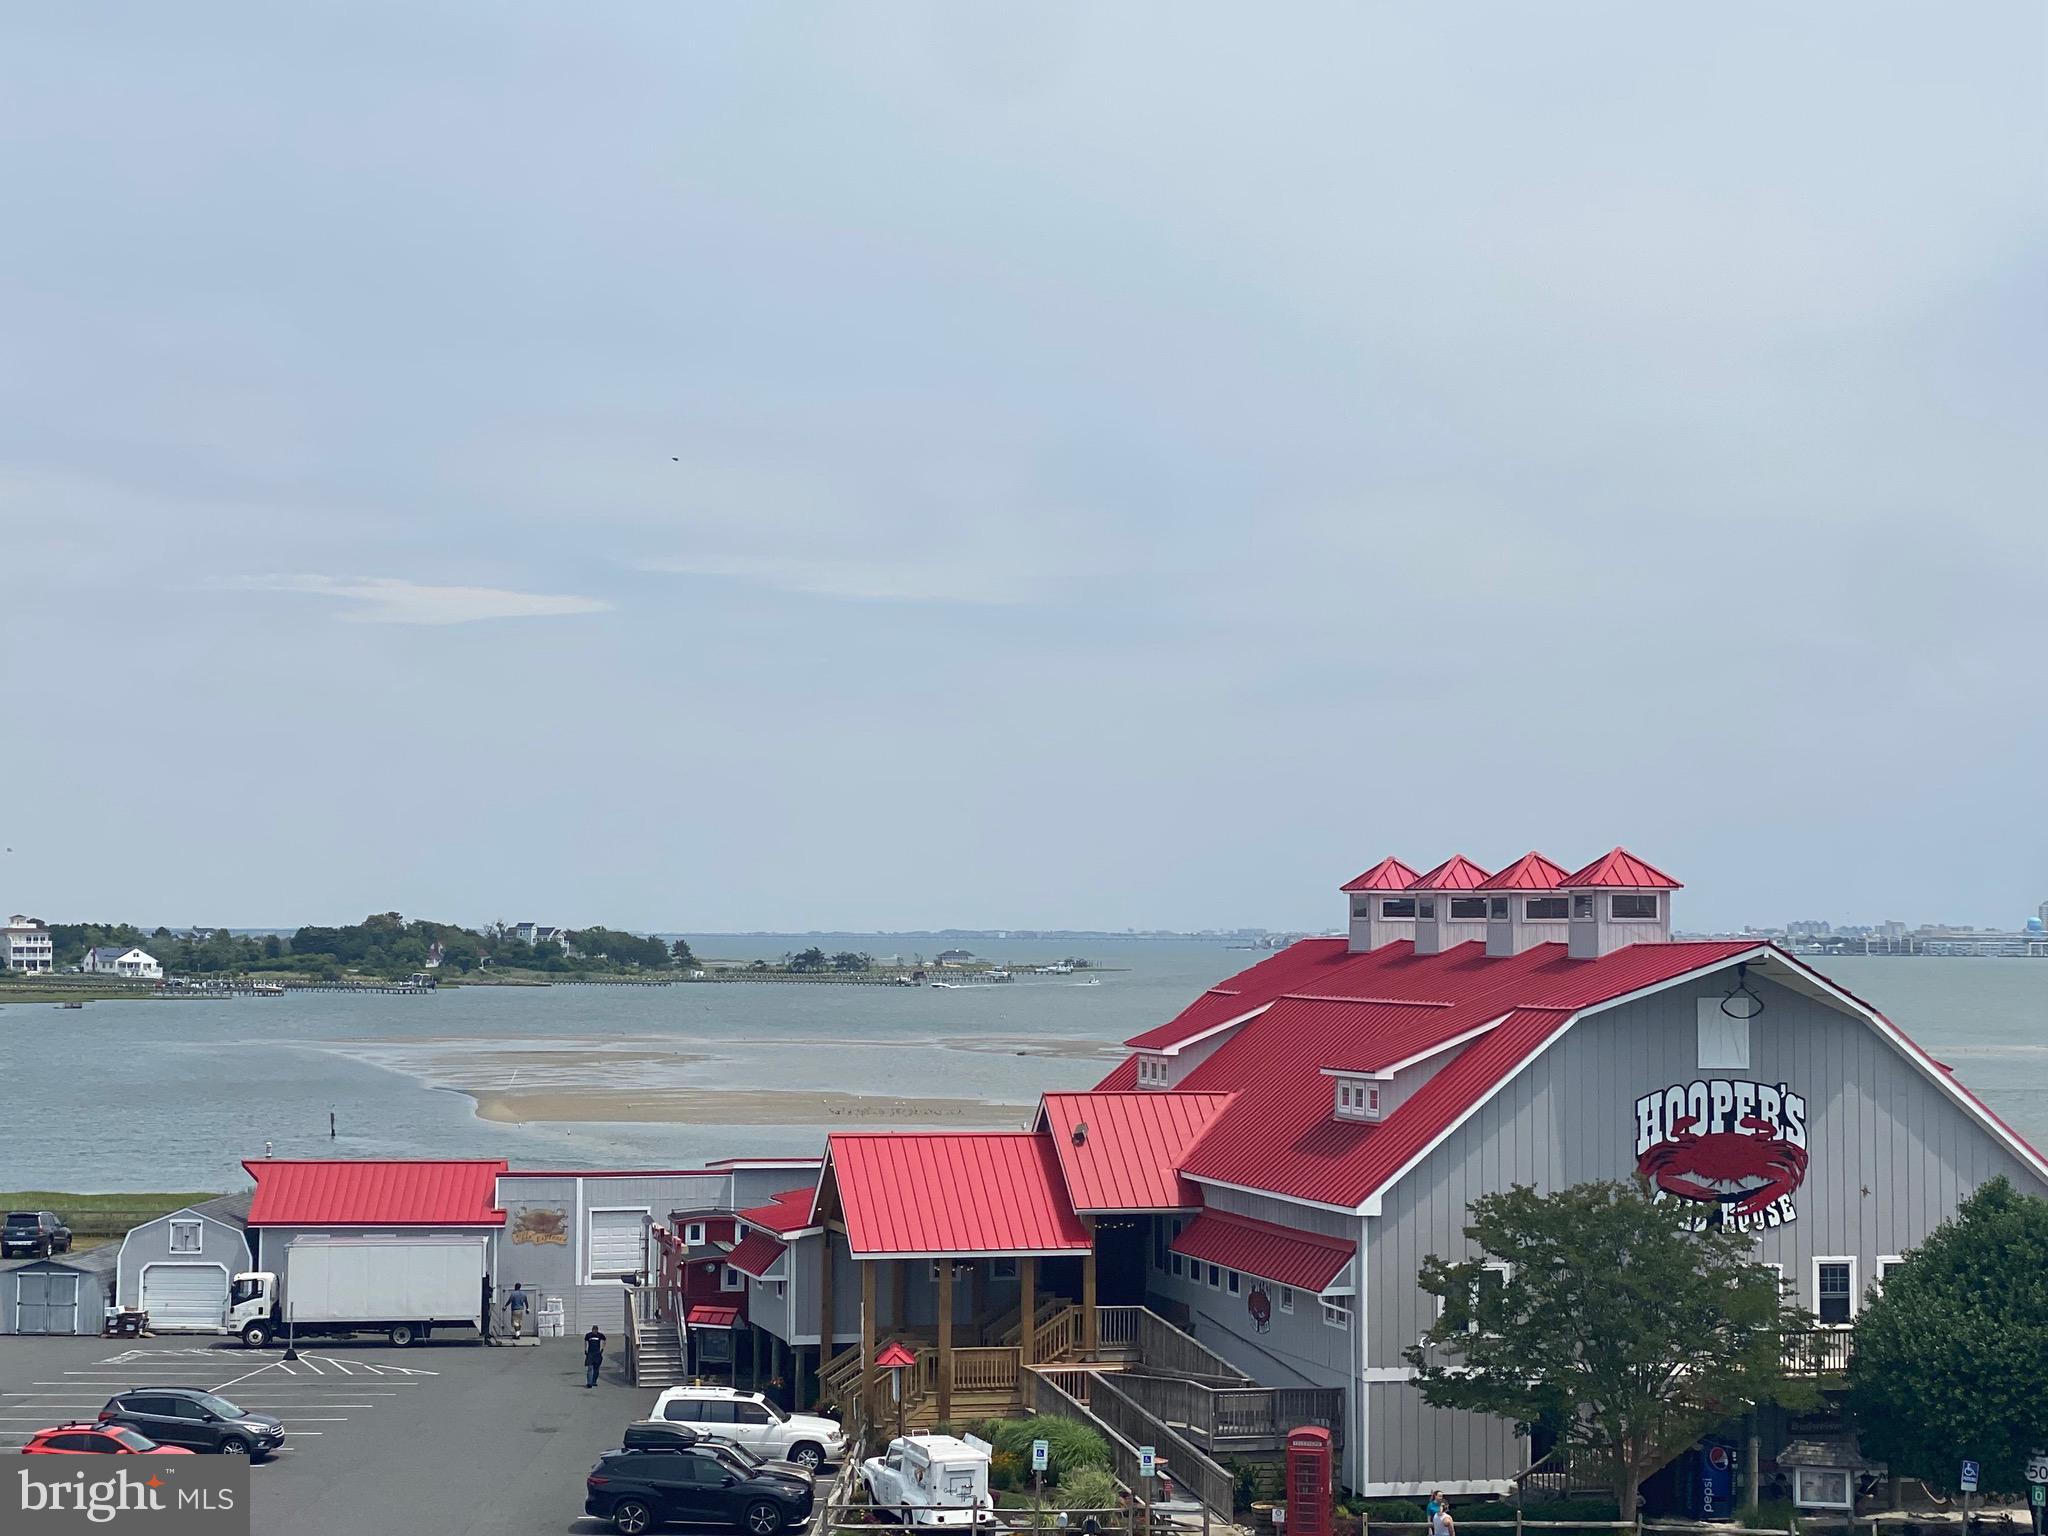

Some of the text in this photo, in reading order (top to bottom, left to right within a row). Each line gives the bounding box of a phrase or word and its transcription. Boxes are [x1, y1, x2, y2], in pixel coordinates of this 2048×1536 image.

[1636, 1079, 1807, 1156] HOOPER'S
[2029, 1464, 2048, 1480] 50
[1703, 1478, 1714, 1513] pepsi
